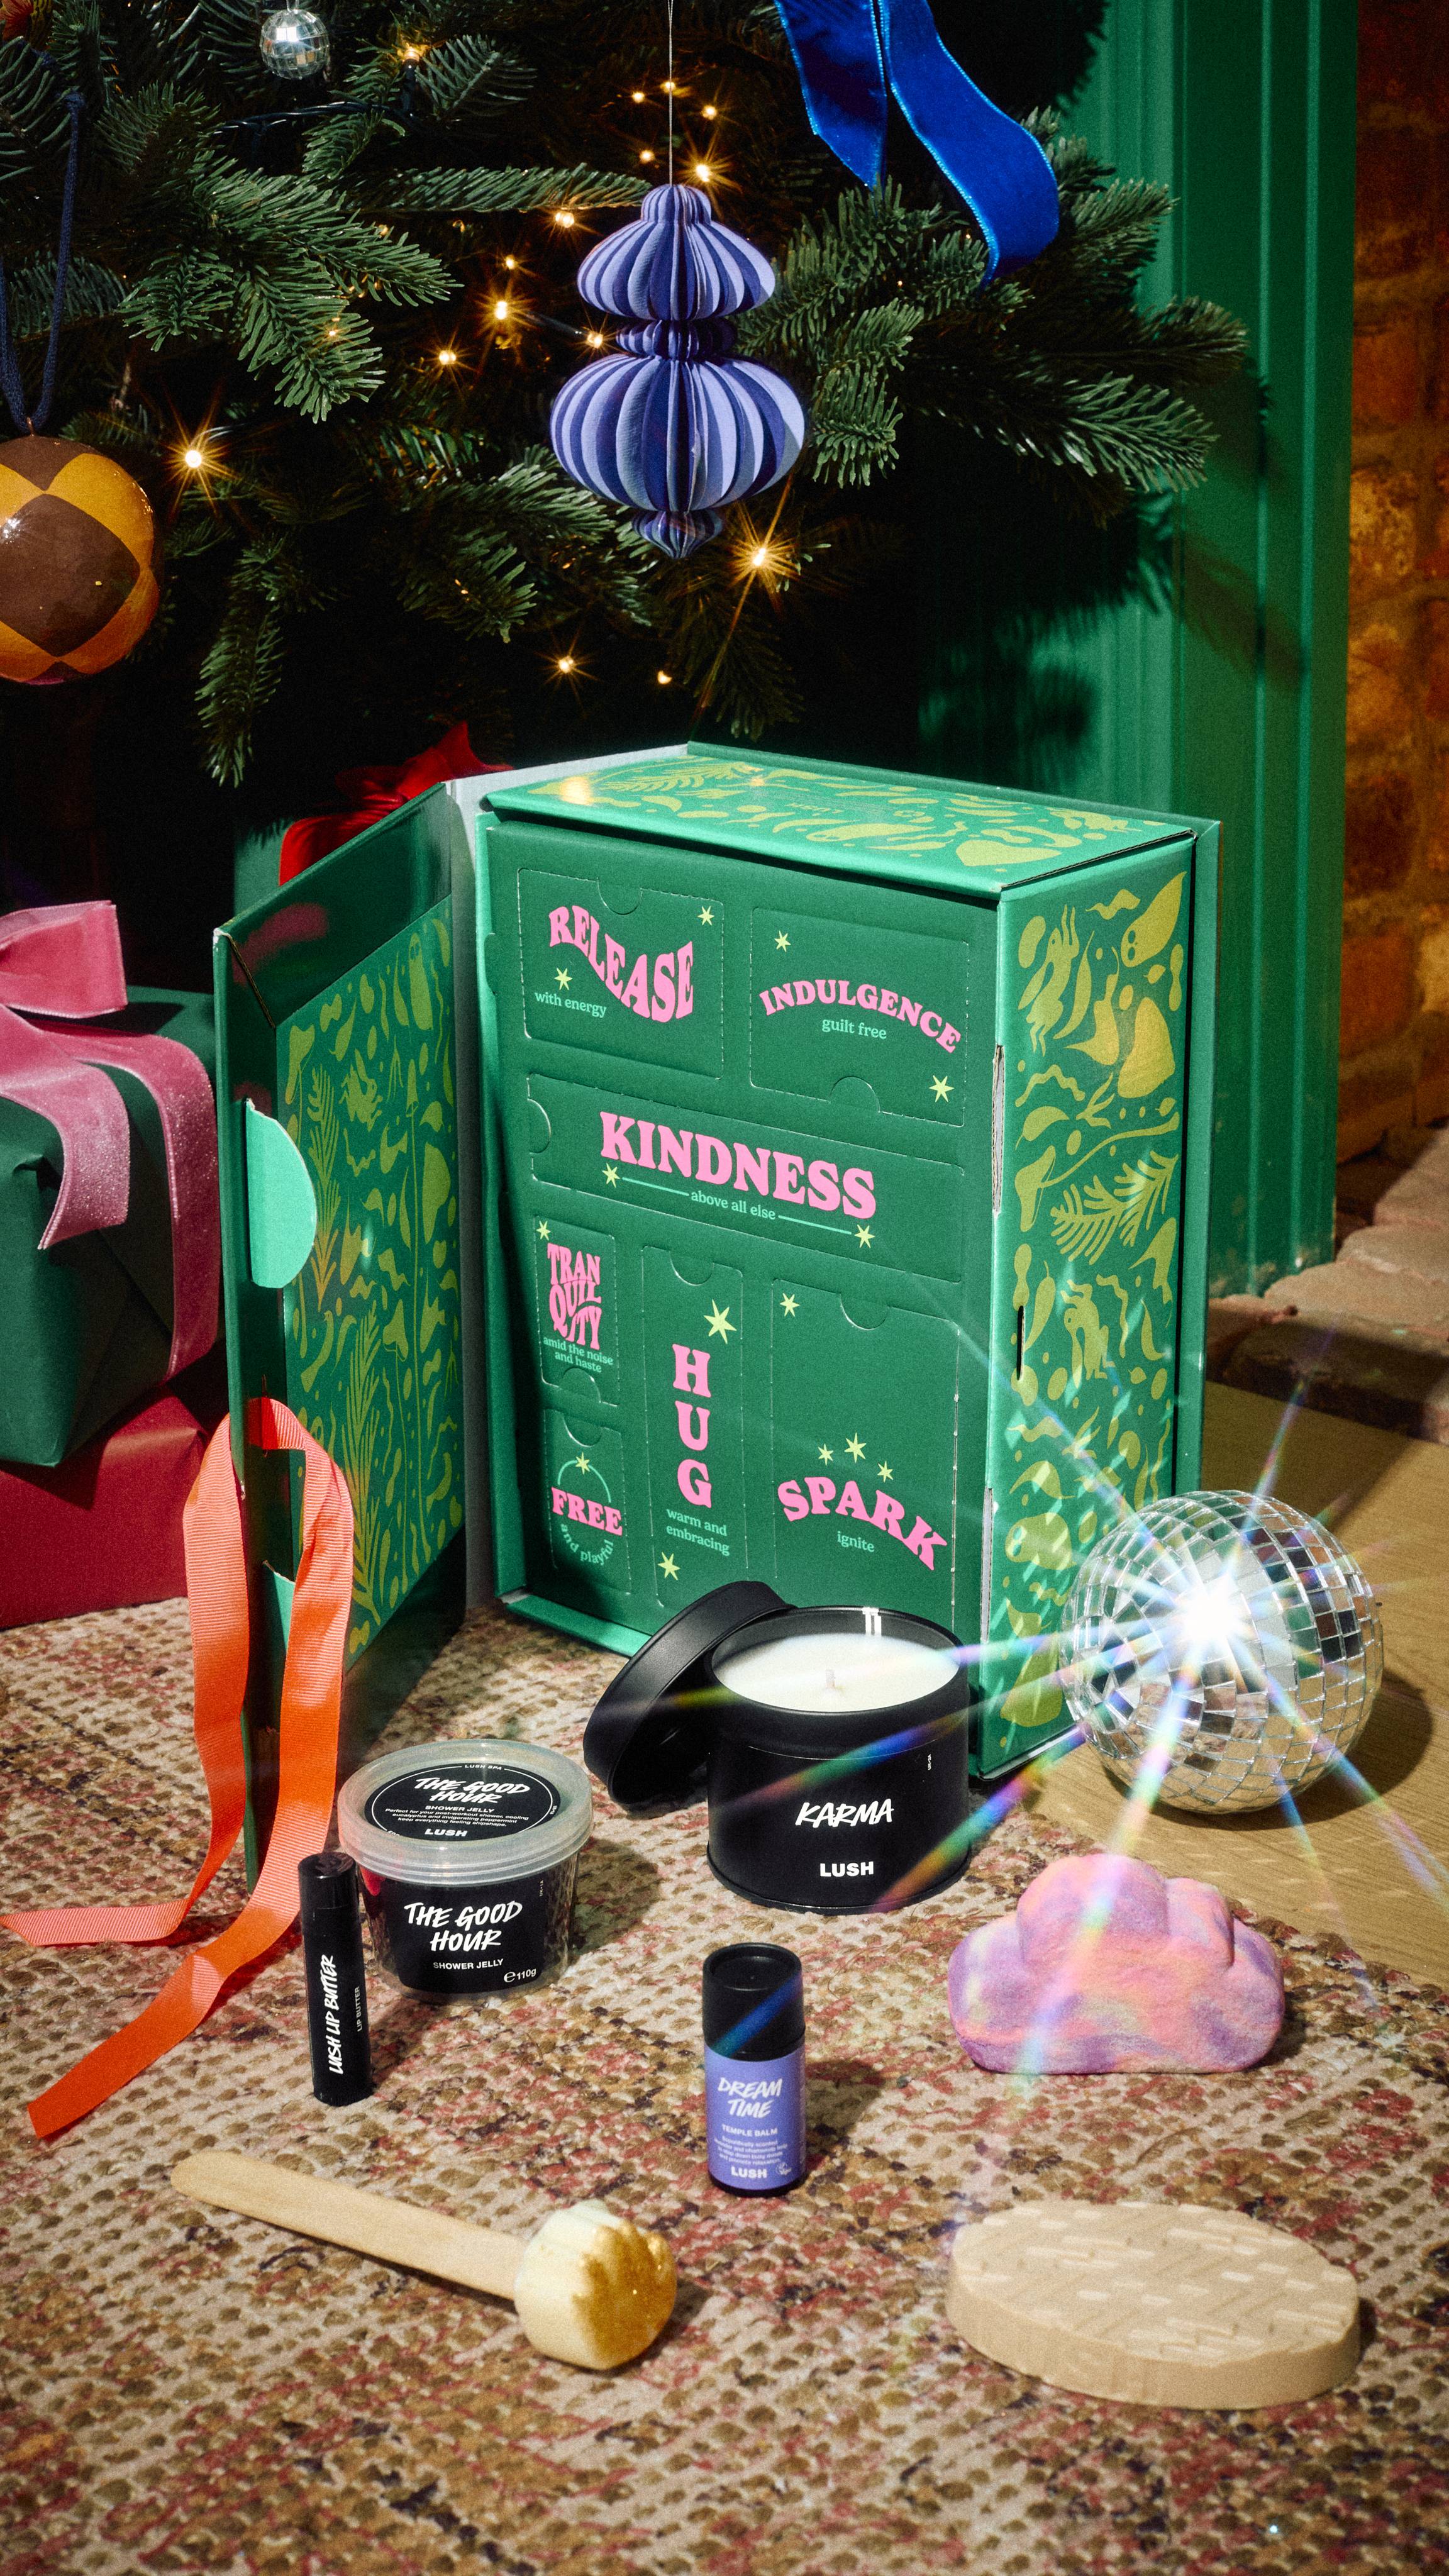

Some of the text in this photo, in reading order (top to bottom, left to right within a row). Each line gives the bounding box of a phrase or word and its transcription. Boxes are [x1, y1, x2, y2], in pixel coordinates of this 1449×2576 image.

[548, 905, 693, 1023] RELEASE
[535, 991, 607, 1018] with energy
[759, 979, 961, 1053] INDULGENCE
[822, 1018, 887, 1040] guilt free
[599, 1111, 876, 1219] KINDNESS
[691, 1190, 775, 1219] above all else
[543, 1336, 613, 1365] amid the noise
[555, 1351, 602, 1373] and haste
[551, 1486, 623, 1536] FREE
[666, 1509, 727, 1537] warm and
[777, 1477, 948, 1570] SPARK
[560, 1523, 614, 1565] and playful
[666, 1524, 730, 1557] embracing
[837, 1531, 875, 1553] ignite
[414, 1777, 530, 1794] THE GOOD
[430, 1790, 502, 1803] HOUR
[795, 1799, 894, 1828] KARMA
[425, 1828, 468, 1837] LUSH
[819, 1862, 875, 1877] LUSH
[404, 1901, 523, 1931] THE GOOD
[430, 1929, 502, 1951] HOUR
[433, 1958, 504, 1970] SHOWER JELLY
[320, 1954, 343, 2075] LUSH LIP BUTTER
[718, 2077, 782, 2099] DREAM
[728, 2099, 774, 2118] TIME
[722, 2123, 778, 2136] TEMPLE BALM
[731, 2166, 767, 2179] LUSH
